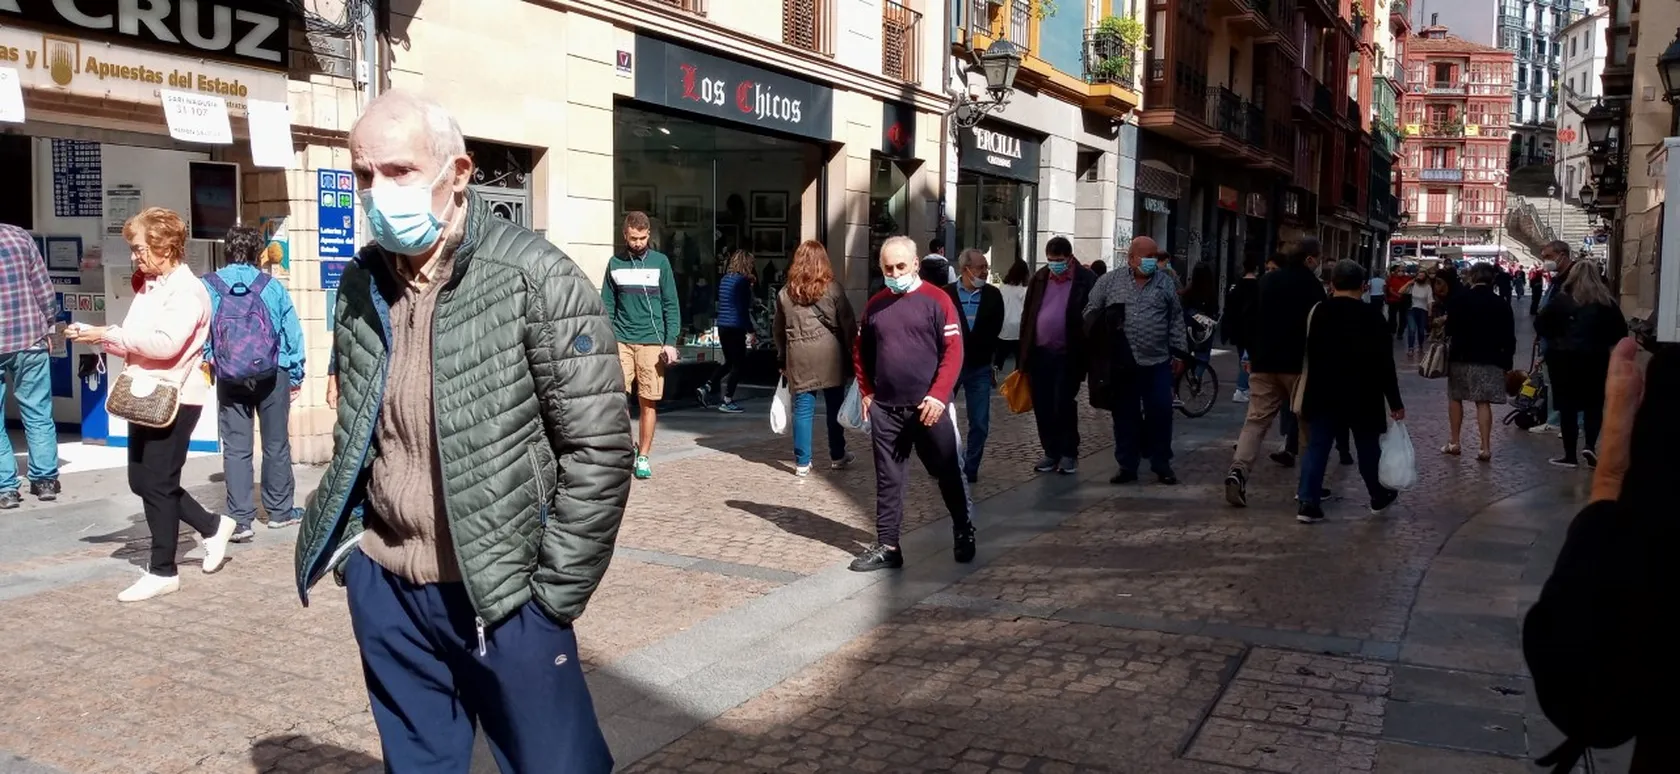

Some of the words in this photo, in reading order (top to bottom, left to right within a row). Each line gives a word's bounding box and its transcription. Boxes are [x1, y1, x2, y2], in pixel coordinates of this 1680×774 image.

[53, 0, 282, 63] CRUZ
[25, 49, 37, 69] y
[85, 56, 164, 85] Apuestas
[168, 69, 193, 89] del
[197, 74, 248, 98] Estado
[680, 63, 726, 106] Los
[736, 79, 802, 123] Chicos
